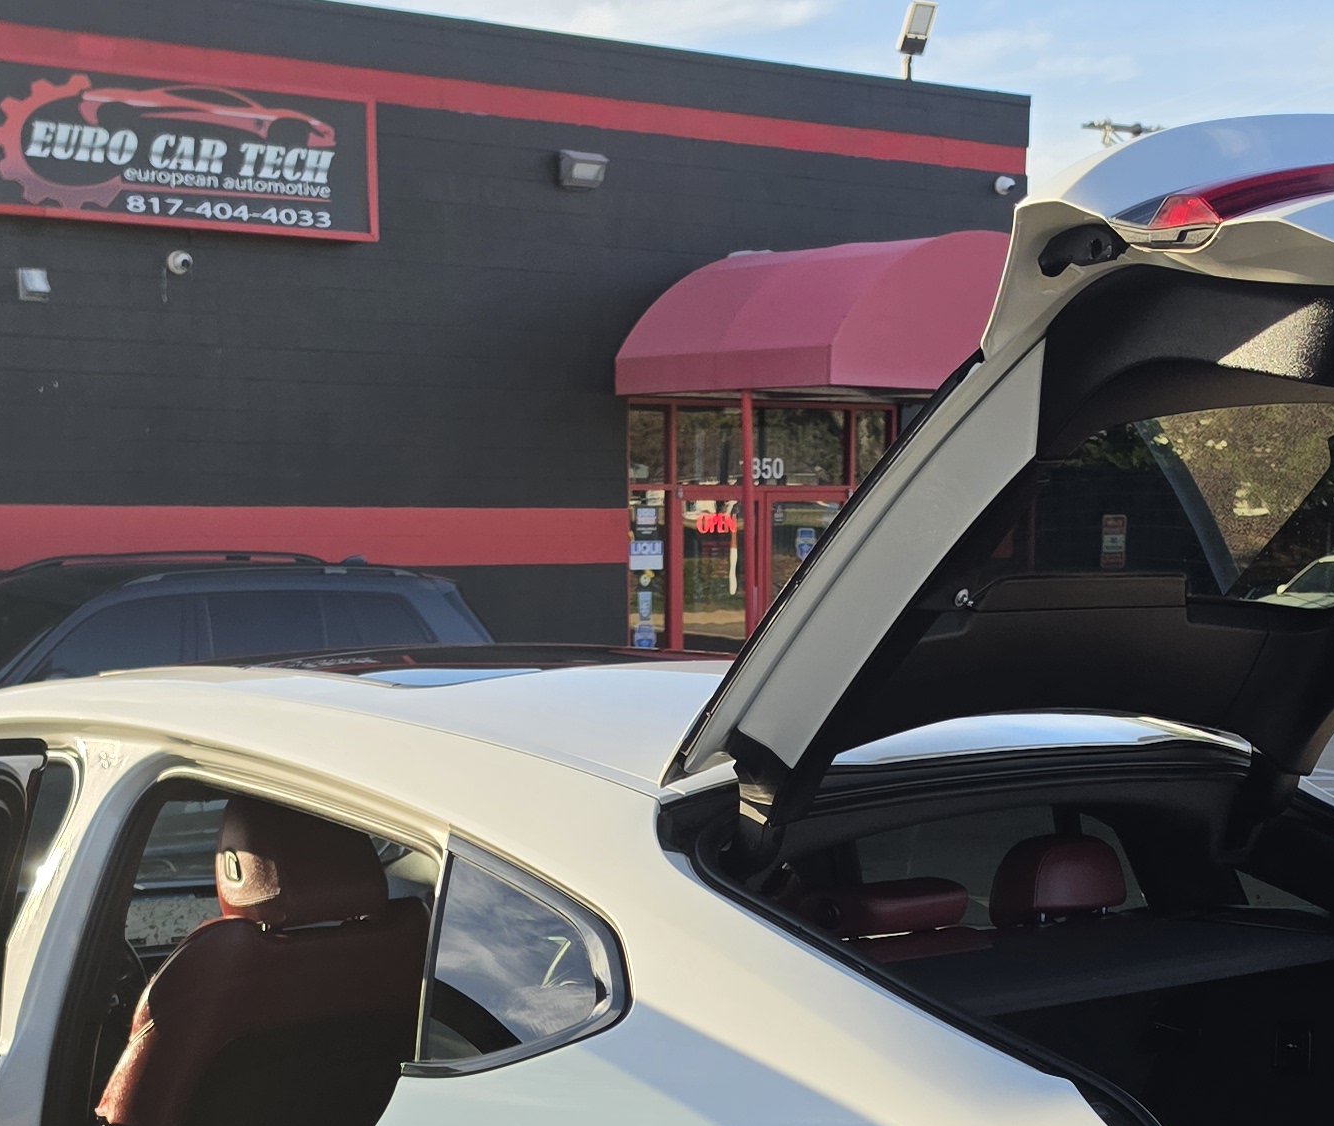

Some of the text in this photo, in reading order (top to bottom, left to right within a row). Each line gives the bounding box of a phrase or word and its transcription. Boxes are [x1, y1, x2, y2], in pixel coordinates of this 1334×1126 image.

[25, 120, 335, 184] EURO CAR TECH
[123, 167, 332, 199] european automotive
[126, 195, 332, 228] 817-404-4033
[696, 512, 737, 534] OPEN
